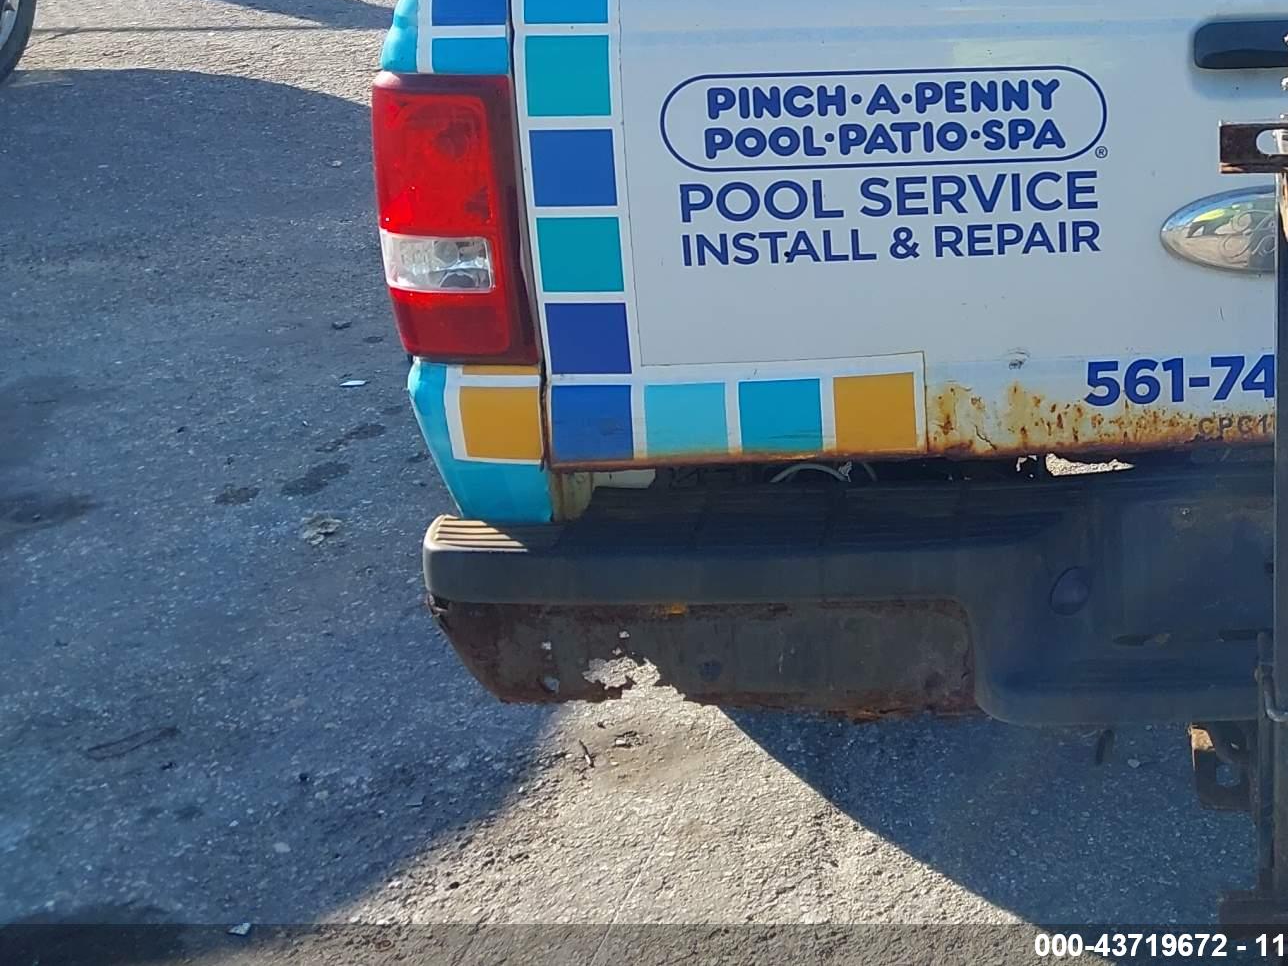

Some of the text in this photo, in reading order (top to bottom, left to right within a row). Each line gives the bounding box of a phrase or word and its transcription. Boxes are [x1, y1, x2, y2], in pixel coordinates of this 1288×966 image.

[679, 170, 1099, 222] POOL SERVICE
[682, 220, 1101, 267] INSTALL & REPAIR
